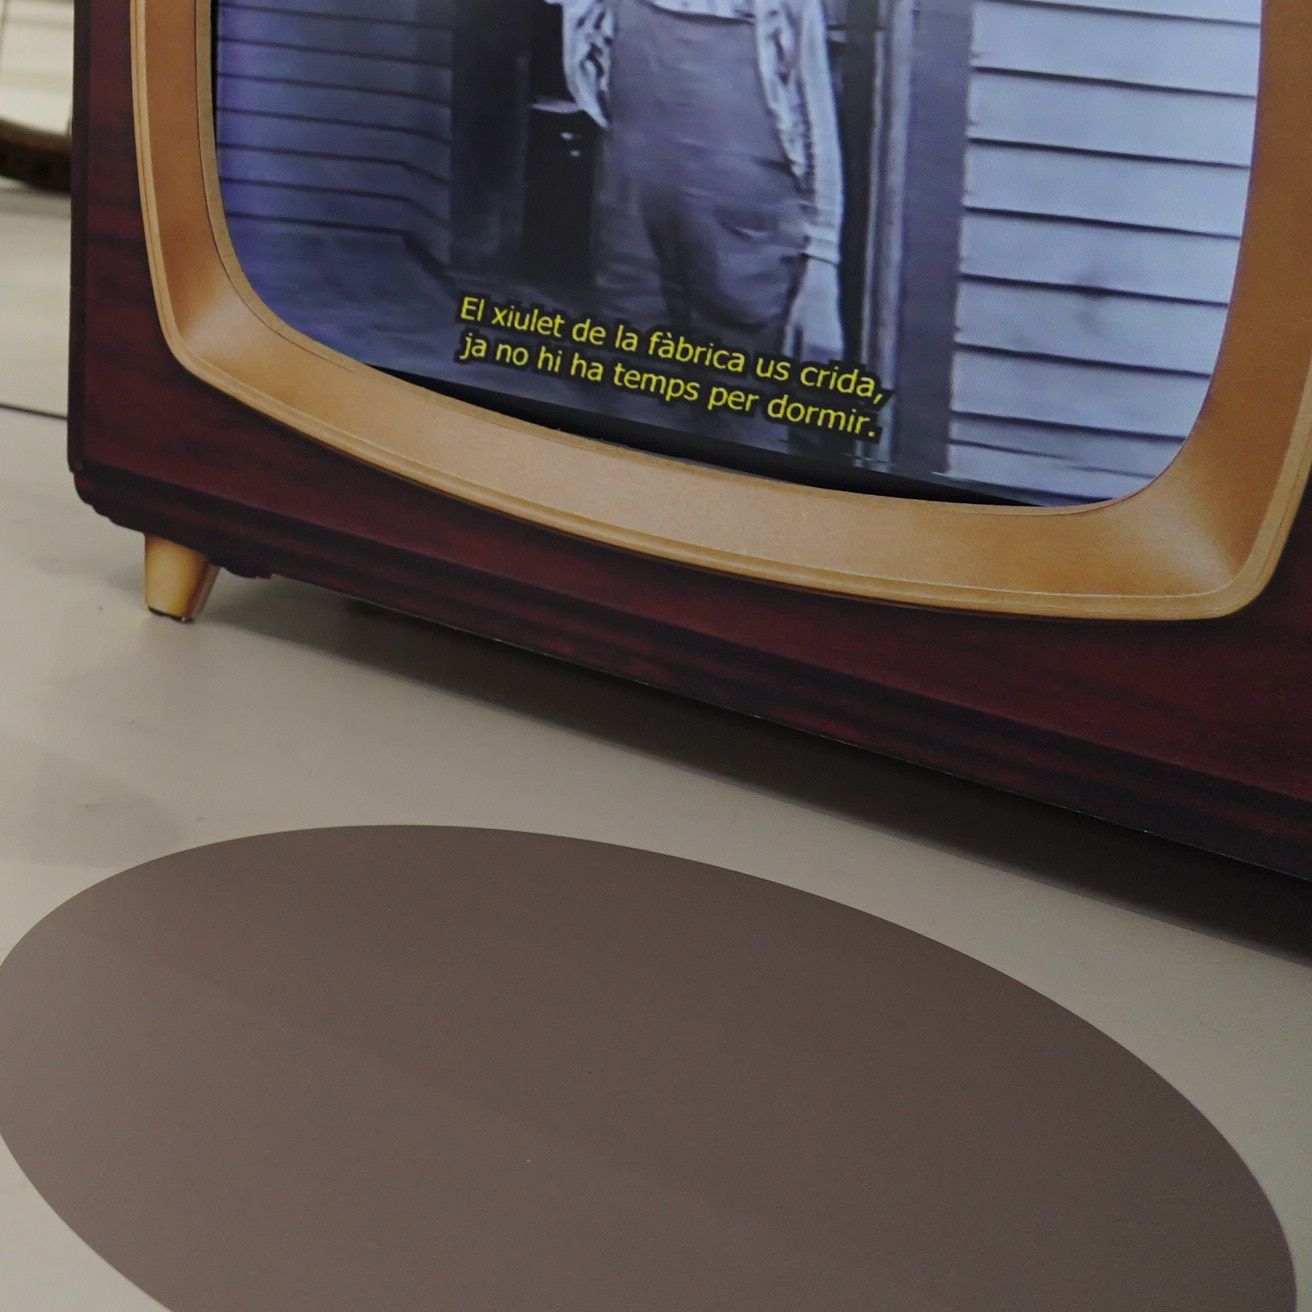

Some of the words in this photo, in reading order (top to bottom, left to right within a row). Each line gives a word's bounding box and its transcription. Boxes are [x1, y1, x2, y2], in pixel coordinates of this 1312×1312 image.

[459, 333, 487, 361] ja
[496, 344, 530, 367] no
[538, 345, 562, 374] hi
[571, 352, 604, 382] ha
[613, 365, 701, 403] temps
[708, 384, 757, 413] per
[767, 392, 878, 439] dormir.
[460, 296, 483, 322] El
[491, 304, 564, 338] xiulet
[572, 318, 607, 346] de
[615, 325, 639, 353] la
[648, 331, 746, 373] fàbrica
[756, 356, 791, 382] us
[800, 364, 884, 405] crida,
